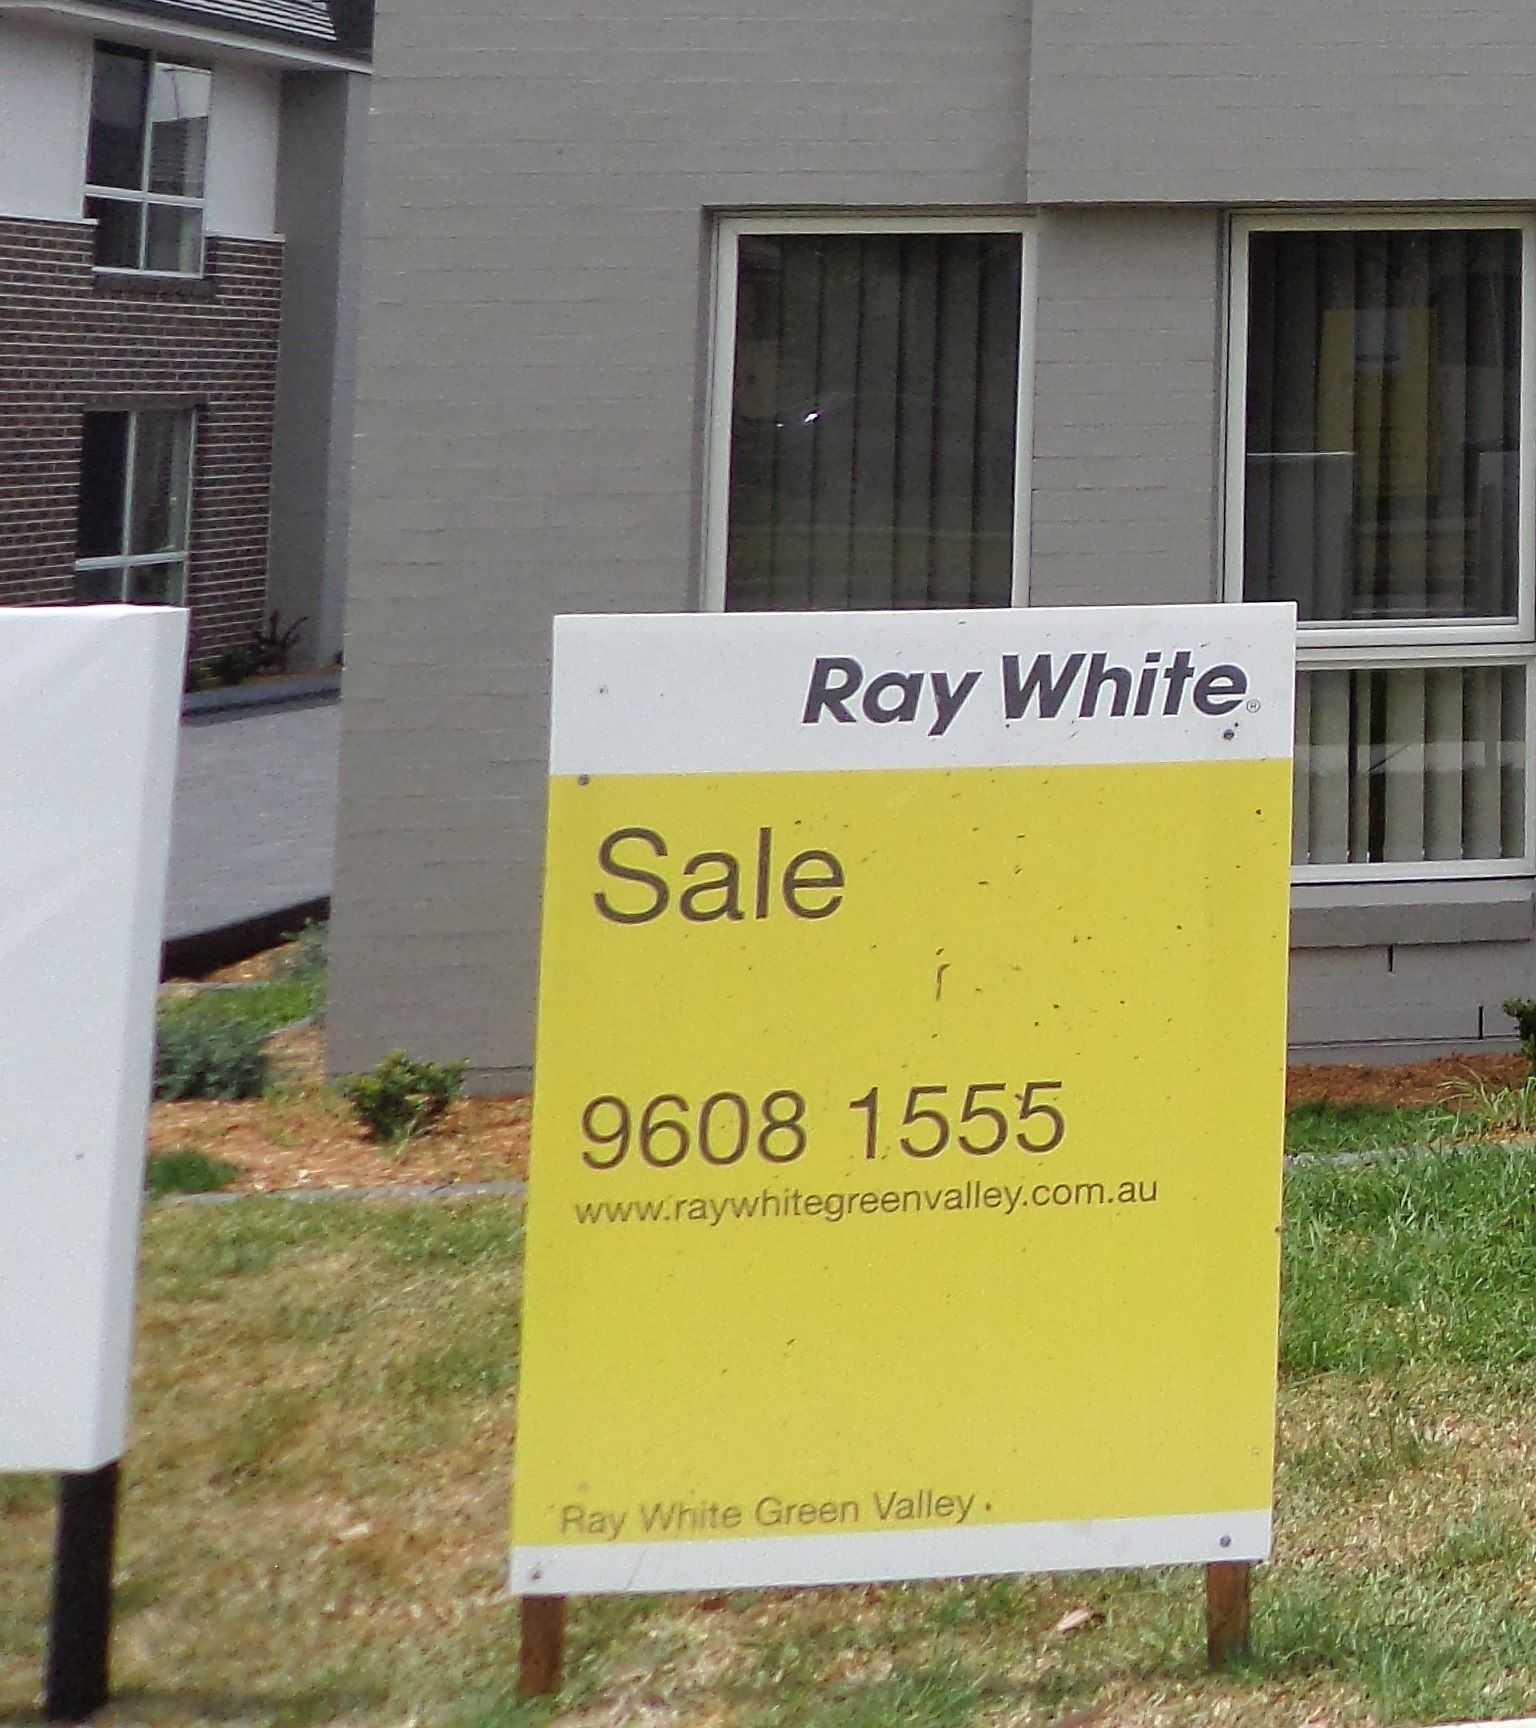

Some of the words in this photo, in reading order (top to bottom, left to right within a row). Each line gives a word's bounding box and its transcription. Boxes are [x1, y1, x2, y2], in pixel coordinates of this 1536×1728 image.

[802, 656, 983, 737] Ray
[1001, 650, 1248, 721] White
[592, 825, 847, 926] Sale
[580, 1088, 808, 1171] 9608
[848, 1080, 1067, 1160] 1555
[574, 1177, 1159, 1227] www.raywhitegreenvalley.com.au
[560, 1503, 627, 1541] Ray
[640, 1499, 742, 1533] White
[754, 1494, 860, 1527] Green
[873, 1488, 976, 1523] Valley
